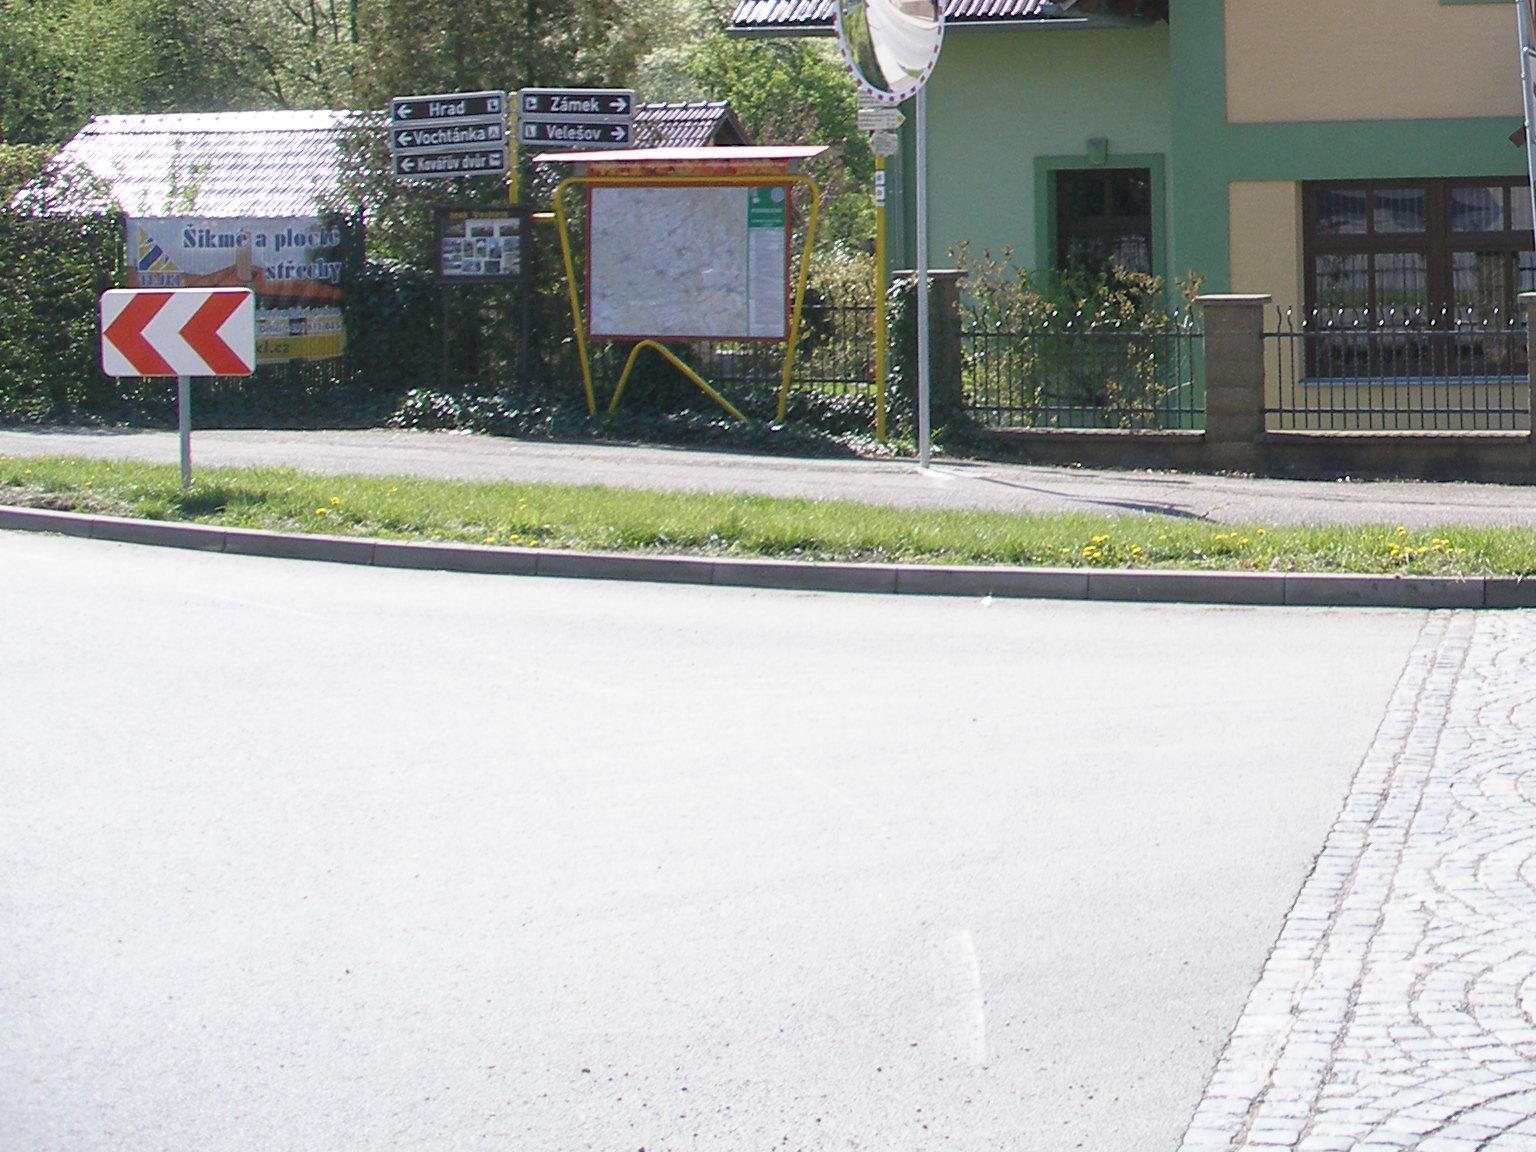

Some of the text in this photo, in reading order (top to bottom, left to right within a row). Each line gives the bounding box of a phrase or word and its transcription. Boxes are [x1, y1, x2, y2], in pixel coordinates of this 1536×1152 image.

[428, 100, 466, 117] Hrad
[550, 96, 600, 112] Zámek
[412, 126, 487, 146] Vochtánka
[546, 124, 602, 140] Velešov
[182, 223, 249, 248] Šikmé
[255, 233, 267, 248] a
[265, 257, 342, 284] střechy
